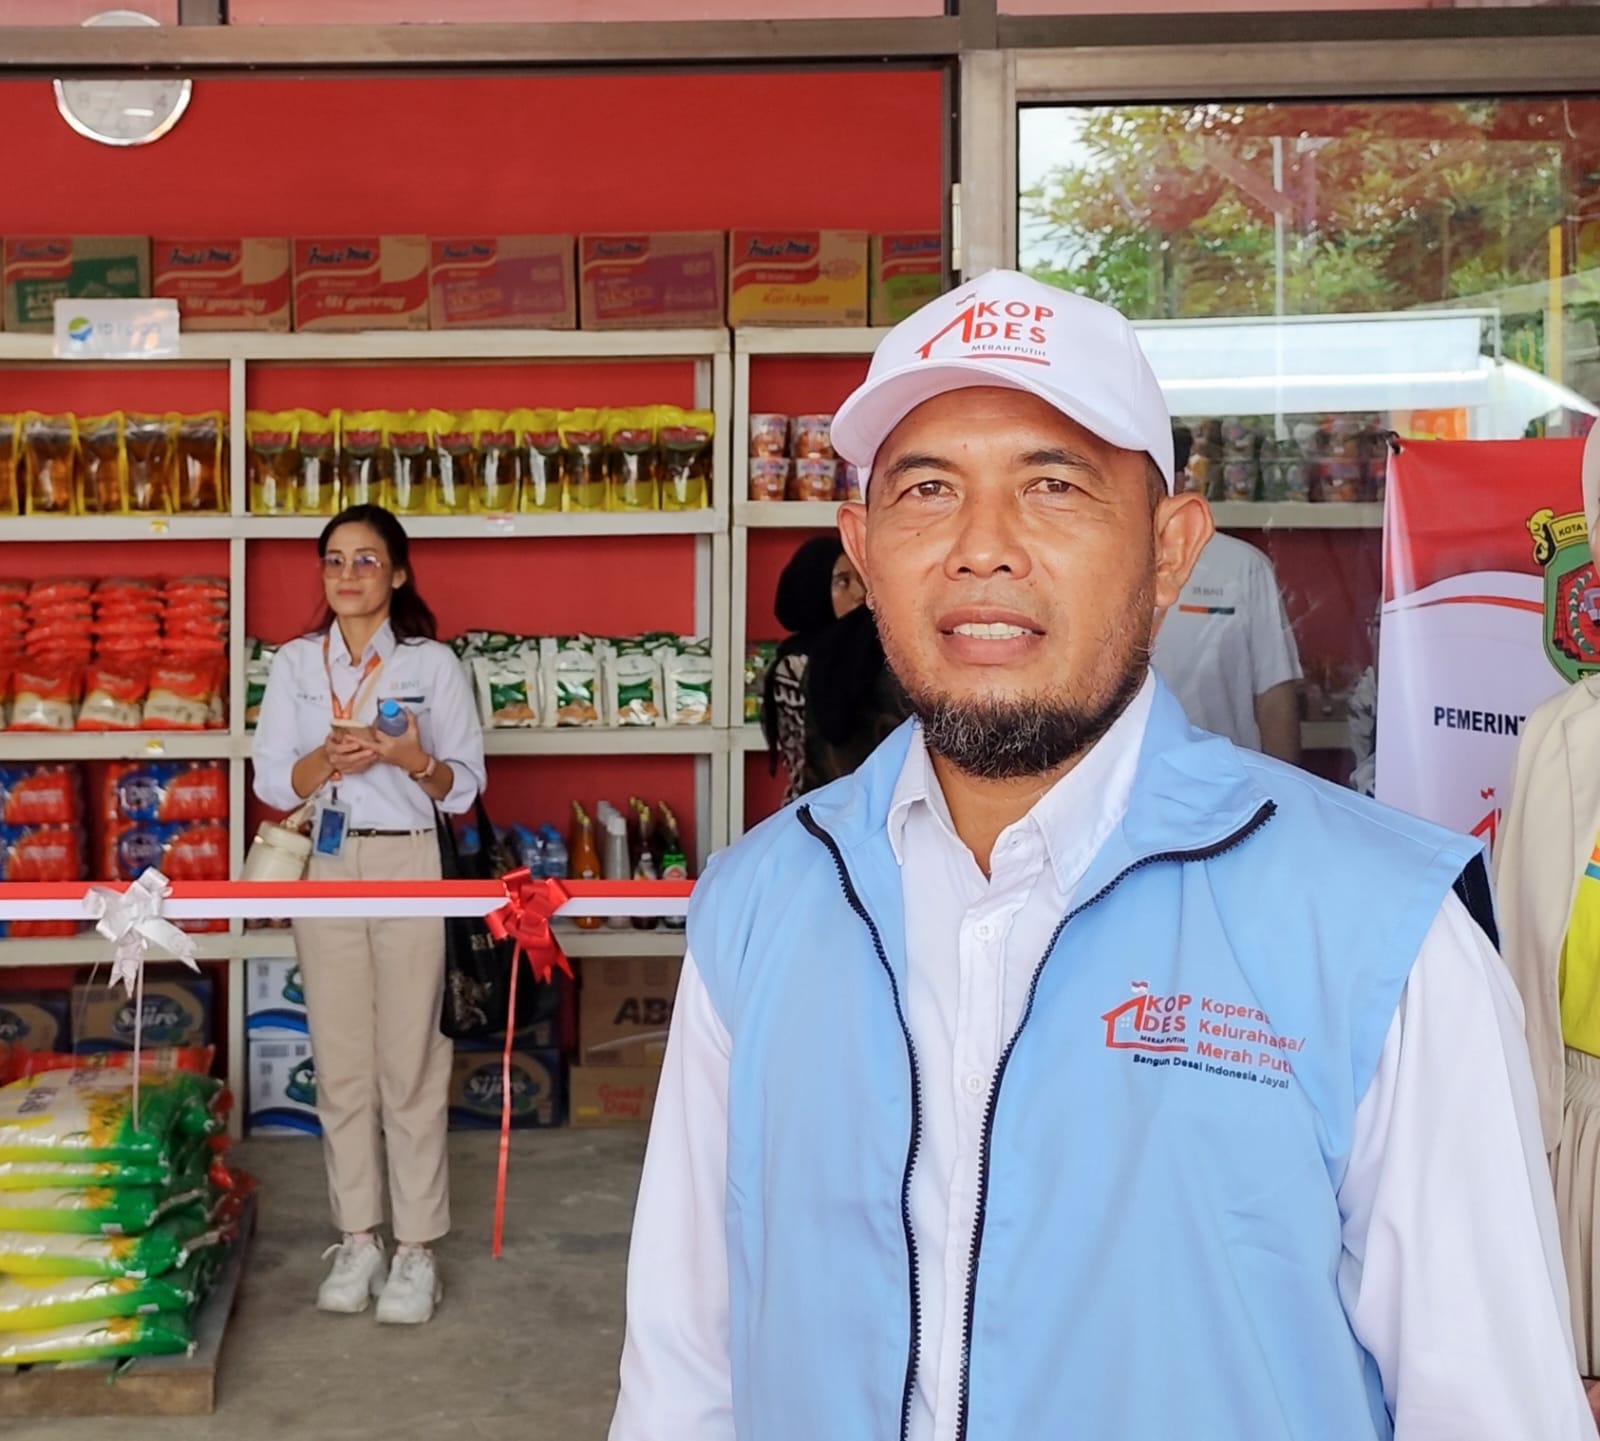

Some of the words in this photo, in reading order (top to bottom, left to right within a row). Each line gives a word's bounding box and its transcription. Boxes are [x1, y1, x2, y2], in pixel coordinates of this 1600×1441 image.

[977, 299, 1055, 322] KOP
[974, 321, 1047, 344] DES
[971, 344, 1011, 352] MERAH
[1014, 345, 1047, 358] PUTIH
[1558, 523, 1584, 538] KOTA
[1146, 994, 1192, 1014] KOP
[1142, 1014, 1187, 1034] DES
[1139, 1034, 1165, 1045] MERAH
[1165, 1035, 1186, 1045] PUTIH
[1196, 1041, 1253, 1065] Merah
[1133, 1054, 1171, 1067] Bangun
[1205, 1062, 1258, 1082] Indonesia
